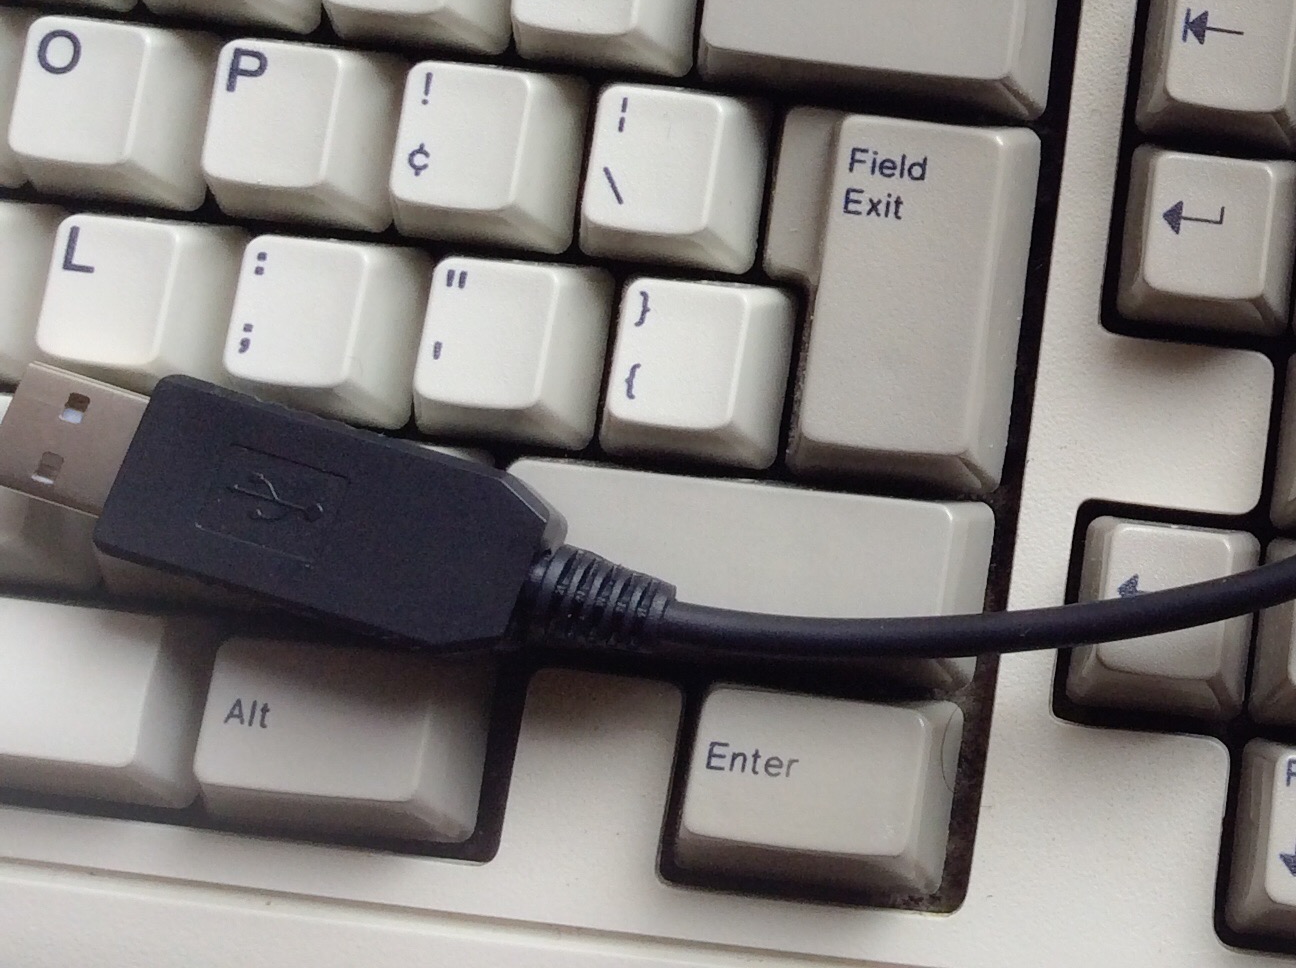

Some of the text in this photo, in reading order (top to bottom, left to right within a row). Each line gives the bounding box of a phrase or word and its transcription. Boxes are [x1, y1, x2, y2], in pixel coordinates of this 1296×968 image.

[38, 30, 81, 74] O
[225, 47, 268, 92] P
[422, 72, 432, 105] !
[849, 148, 927, 181] Field
[844, 188, 903, 219] Exit
[61, 226, 95, 274] L
[635, 291, 650, 326] }
[239, 324, 253, 353] ;
[625, 364, 640, 399] {
[225, 698, 270, 728] Alt
[706, 742, 798, 776] Enter
